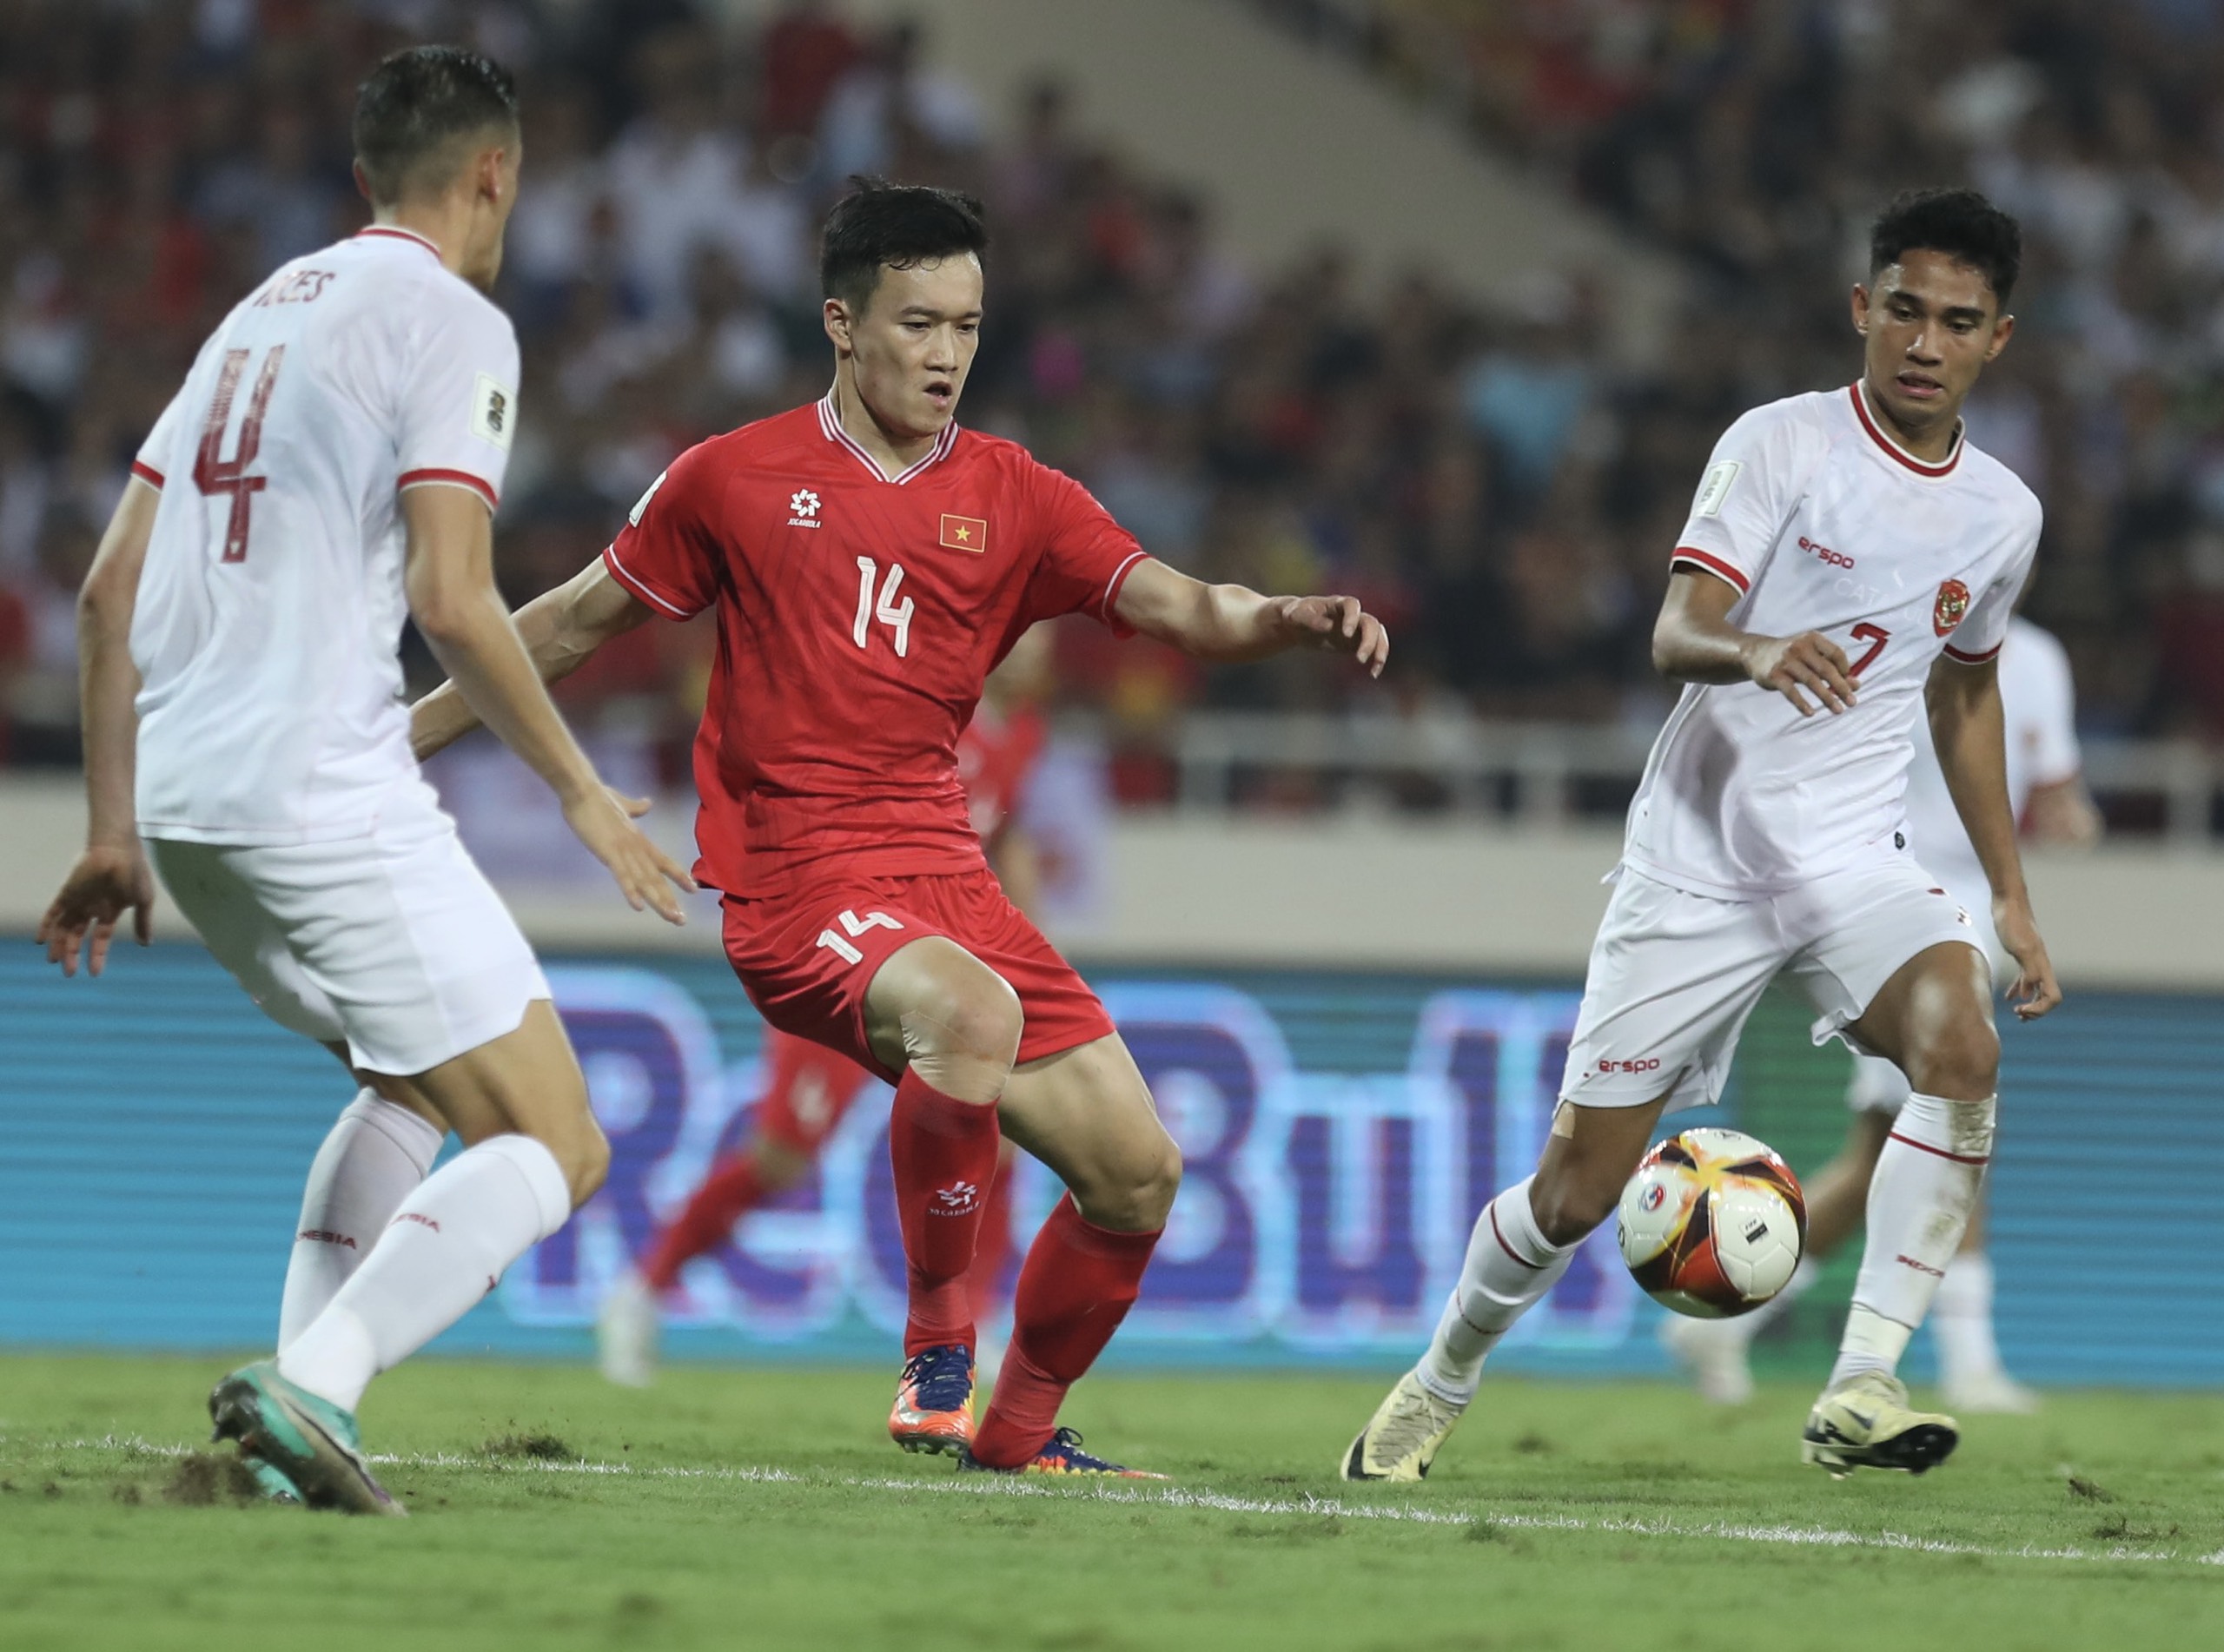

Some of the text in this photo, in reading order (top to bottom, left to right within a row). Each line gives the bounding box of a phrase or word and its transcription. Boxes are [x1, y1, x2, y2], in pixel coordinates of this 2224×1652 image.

[192, 344, 286, 564] 4
[1798, 536, 1855, 570] erspo
[855, 555, 916, 657] 14
[1848, 622, 1892, 677] 7
[816, 909, 904, 966] 14
[1599, 1059, 1660, 1074] erspo
